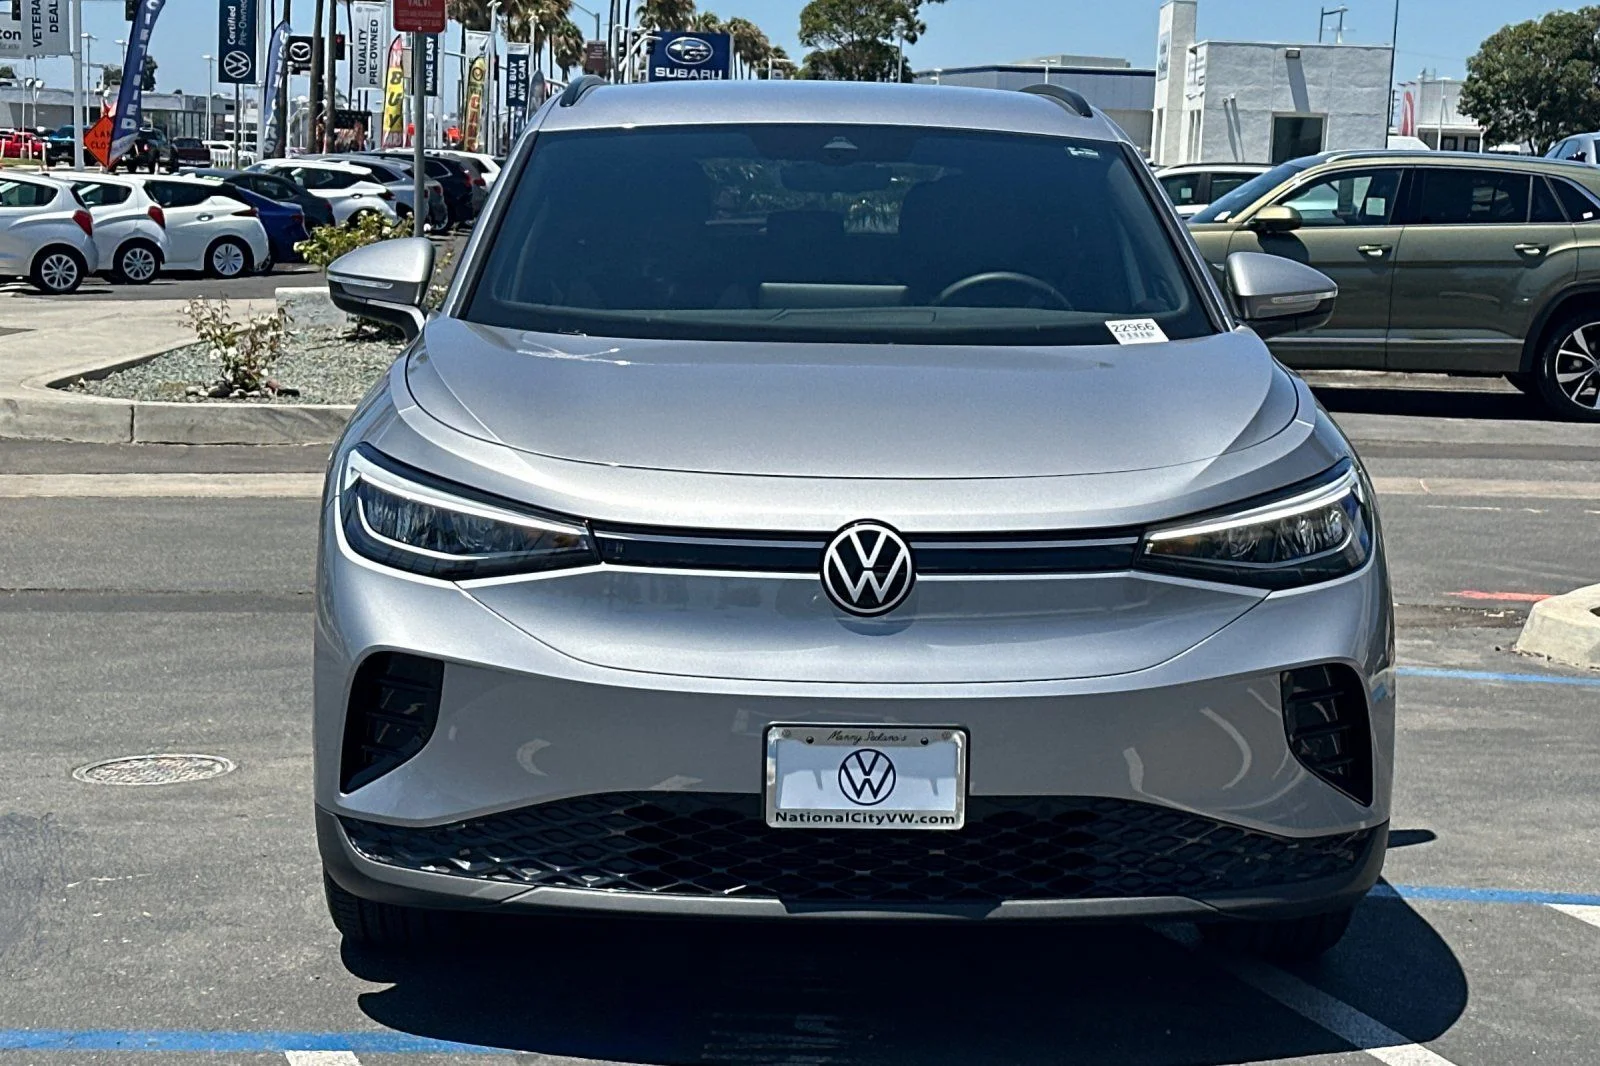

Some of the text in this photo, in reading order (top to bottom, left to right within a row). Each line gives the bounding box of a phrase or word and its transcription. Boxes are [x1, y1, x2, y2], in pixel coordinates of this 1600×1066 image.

[227, 6, 236, 45] Certified
[358, 29, 367, 75] QUALITY
[369, 19, 378, 85] PRE-OWNED
[425, 37, 434, 91] MADE EASY
[508, 62, 517, 98] WE BUY
[518, 60, 526, 79] CAR
[655, 68, 722, 80] SUBARU
[387, 71, 403, 129] BUY
[518, 83, 526, 101] ANY
[1111, 323, 1155, 332] 22966
[827, 730, 862, 745] Manny
[775, 812, 955, 825] NationalCityVW.com
